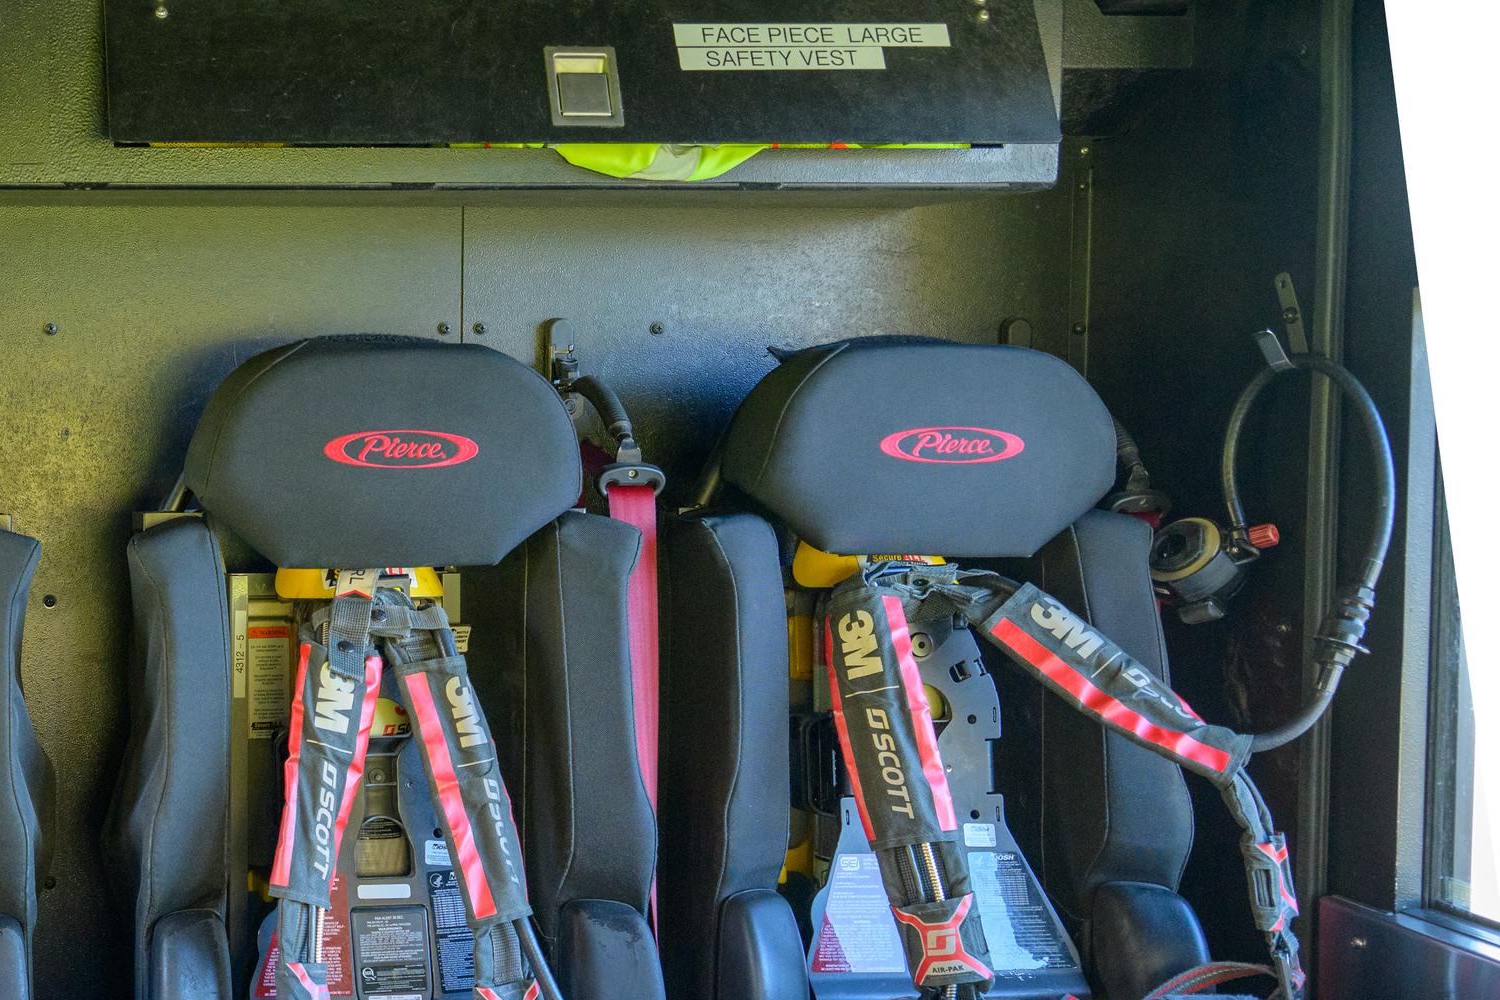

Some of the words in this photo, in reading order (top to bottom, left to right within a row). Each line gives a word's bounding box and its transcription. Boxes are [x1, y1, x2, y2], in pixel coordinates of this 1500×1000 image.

[702, 27, 761, 43] FACE
[768, 27, 835, 43] PIECE
[847, 27, 923, 43] LARGE
[706, 49, 792, 67] SAFETY
[799, 49, 857, 66] VEST
[358, 435, 443, 462] Pierce
[912, 431, 991, 457] Pierce
[1030, 598, 1104, 659] 3M
[236, 652, 245, 674] 4312
[445, 676, 487, 749] 3M
[837, 609, 885, 681] 3M
[873, 731, 916, 820] SCOTT
[309, 792, 338, 880] SCOTT
[932, 964, 965, 973] AIR-PAK
